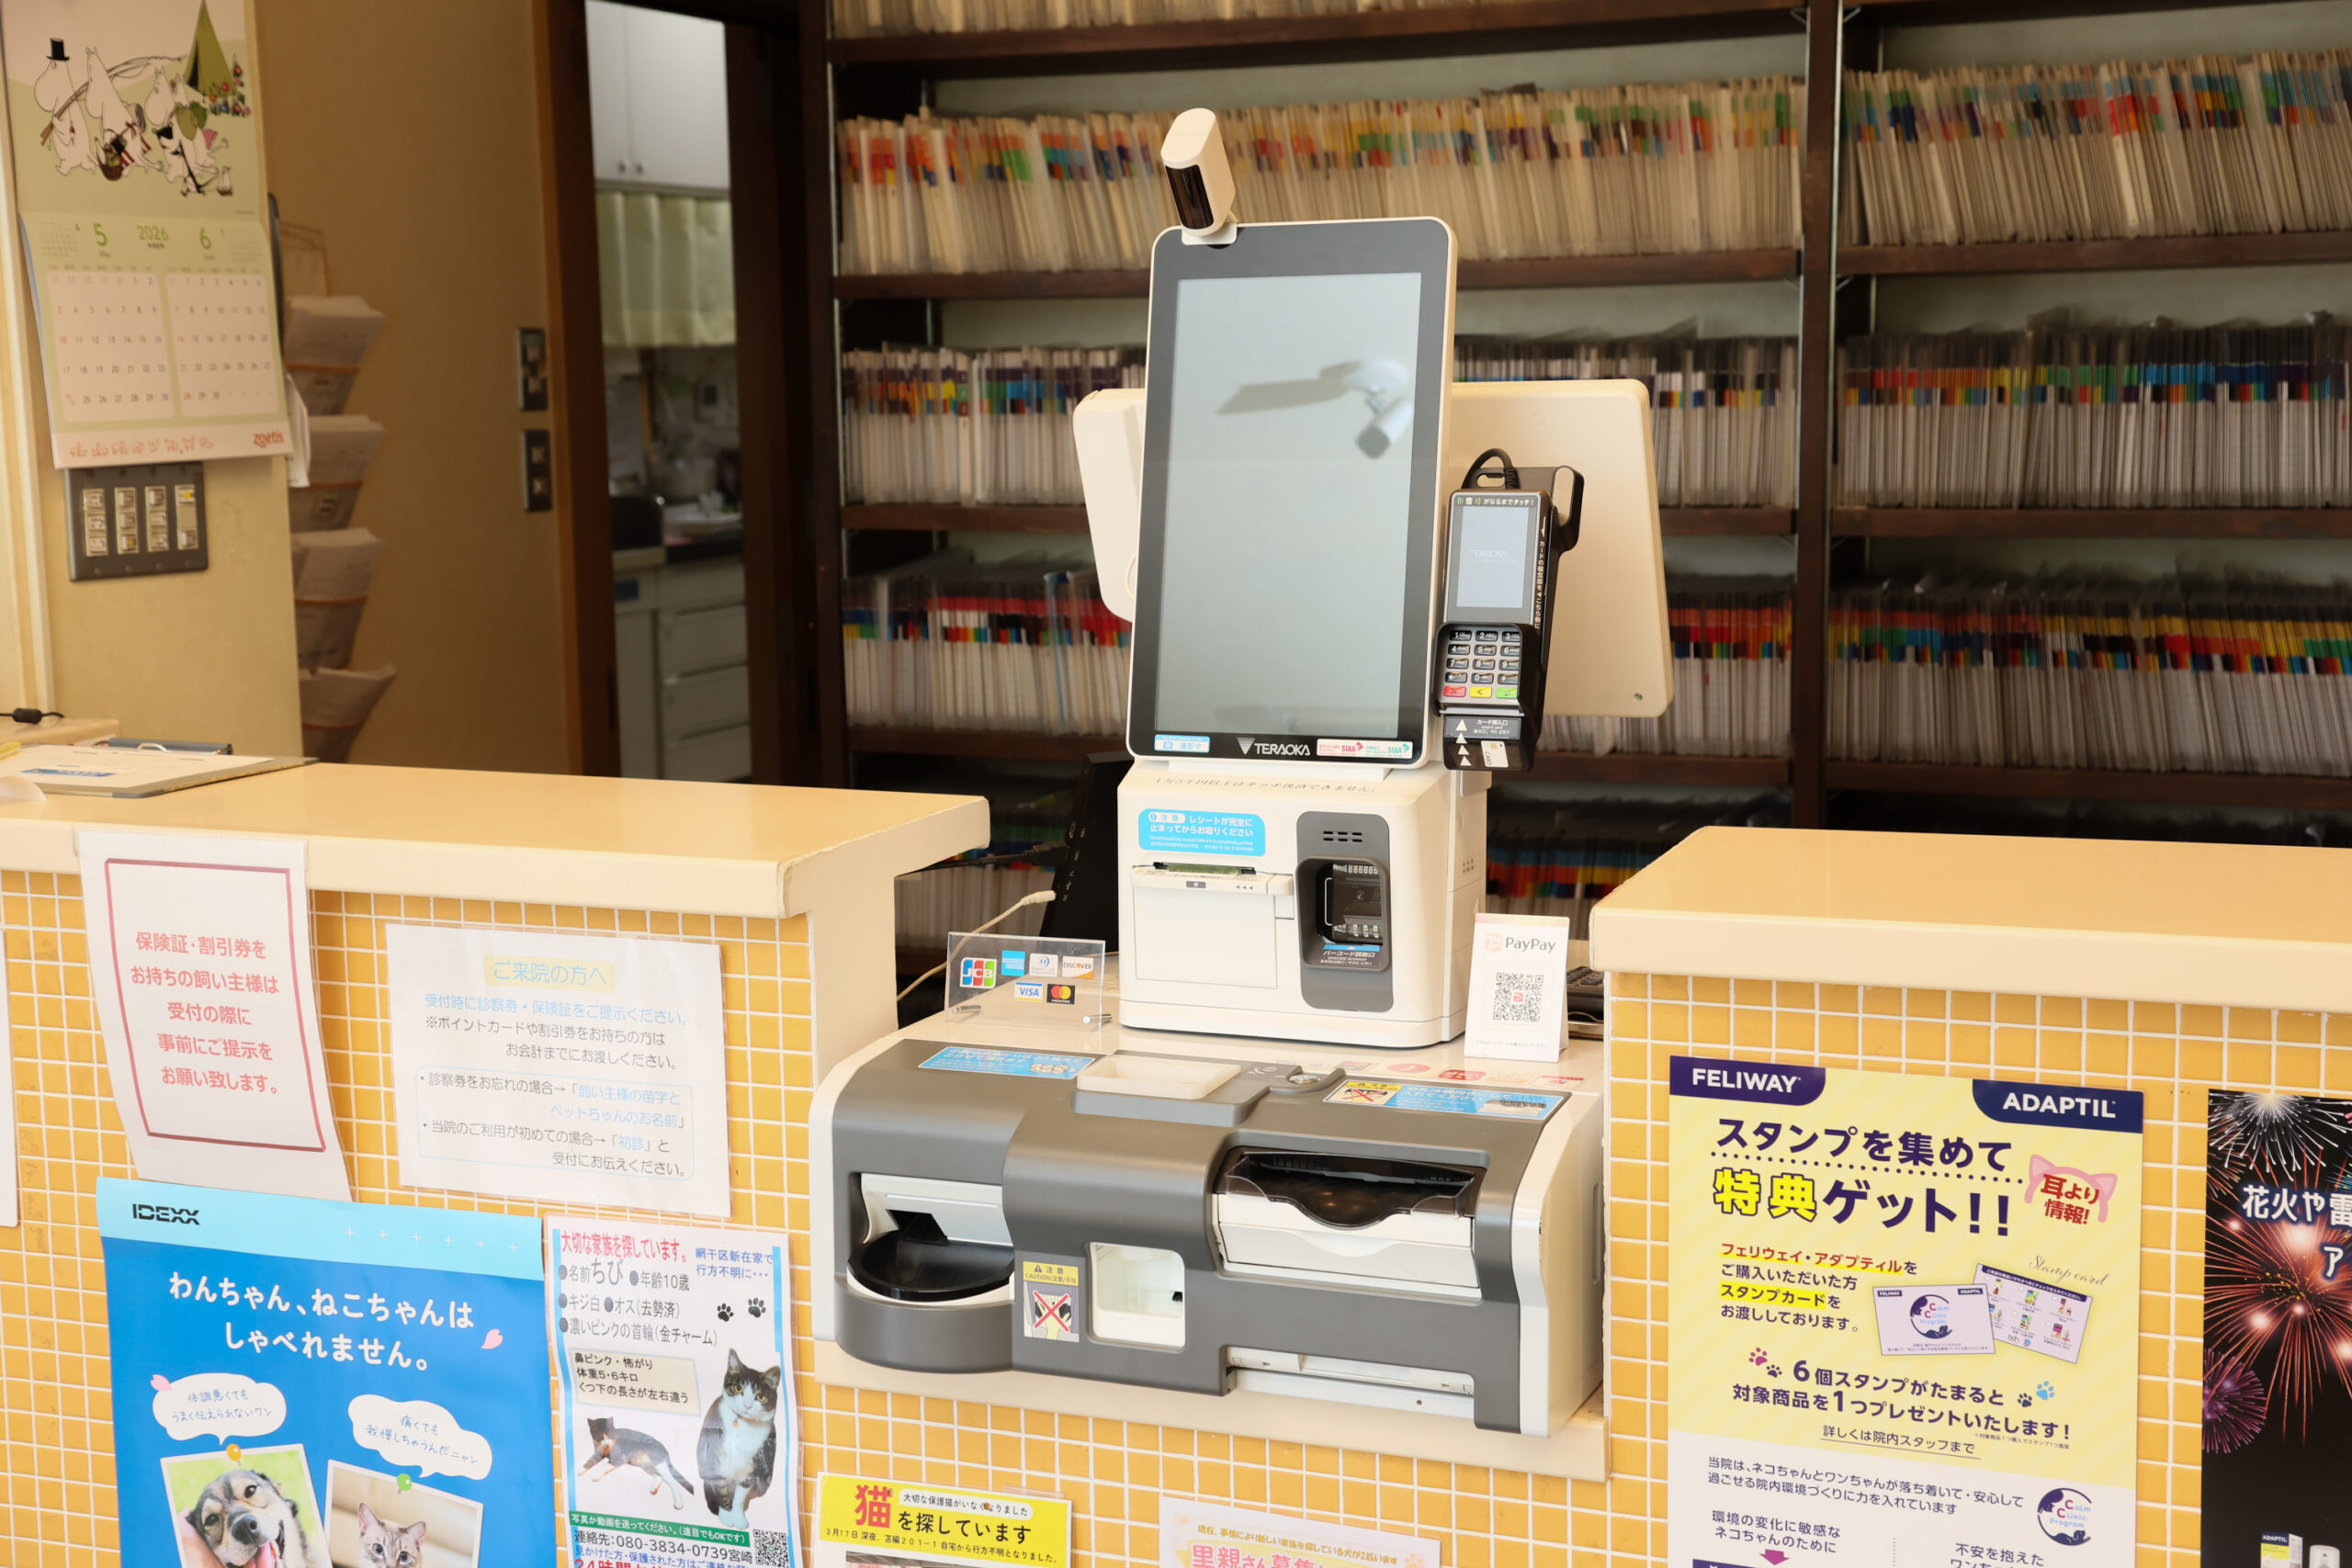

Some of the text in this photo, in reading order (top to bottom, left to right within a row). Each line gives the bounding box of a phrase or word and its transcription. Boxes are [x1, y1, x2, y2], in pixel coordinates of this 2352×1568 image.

[93, 223, 108, 246] 5
[136, 225, 169, 241] 2026
[199, 227, 211, 250] 6
[253, 429, 286, 448] zoetis
[1254, 743, 1311, 756] TERAOKA
[1150, 824, 1254, 837] 止まってからお取りください
[1189, 815, 1253, 828] レシートが完全に
[135, 931, 267, 960] 保険証・割引券を
[1505, 937, 1556, 953] PayPay
[130, 966, 279, 995] お持ちの飼い主様は
[493, 960, 607, 986] ご来院の方へ
[1020, 987, 1039, 997] VISA
[167, 1002, 253, 1026] 受付の際に
[157, 1033, 273, 1061] 事前にご提示を
[506, 1043, 677, 1070] お会計までにお渡しください。
[161, 1066, 277, 1095] お願い致します。
[1692, 1068, 1798, 1093] FELIWAY
[2003, 1092, 2116, 1119] ADAPTIL
[1716, 1118, 2012, 1172] スタンプを集めて
[552, 1151, 686, 1178] 受付にお伝えください。
[2041, 1173, 2100, 1204] 耳より
[132, 1203, 200, 1225] IDEXX
[2044, 1199, 2090, 1225] 情報!
[561, 1230, 686, 1264] 大切な家族を探しています。
[695, 1247, 774, 1265] 網干区新在家で
[1722, 1243, 1917, 1275] フェリウェイ・アダプティルを
[2029, 1255, 2110, 1287] Stamp card
[2324, 1246, 2344, 1278] ア
[1722, 1263, 1858, 1291] ご購入いただいた方
[169, 1271, 475, 1330] わんちゃん、ねこちゃんは
[1721, 1284, 1841, 1310] スタンプカードを
[1929, 1303, 1950, 1312] Calm
[1721, 1305, 1858, 1333] お渡ししております。
[1924, 1310, 1947, 1319] Clinic
[225, 1322, 429, 1371] しゃべれません。
[579, 1382, 688, 1404] くつ下の長さが左右違う
[1792, 1360, 2005, 1406] 6個スタンプがたまると
[187, 1389, 249, 1404] 体調悪くても
[171, 1407, 273, 1423] うまく伝えられないワン
[1733, 1383, 2070, 1440] 対象商品を1つプレゼントいたします!
[401, 1415, 439, 1436] 痛くても
[1823, 1425, 1975, 1455] 詳しくは院内スタッフまで
[854, 1484, 892, 1529] 猫
[1708, 1472, 1958, 1515] 過ごせる院内環境づくりに力を入れています
[2064, 1499, 2091, 1513] Calm
[1713, 1510, 1840, 1539] 環境の変化に敏感な
[2057, 1508, 2086, 1521] Clinic
[898, 1511, 1032, 1545] を探しています
[1715, 1526, 1838, 1553] ネコちゃんのために
[2262, 1535, 2288, 1543] ADAPTIL
[1955, 1543, 2044, 1567] 不安を抱えた
